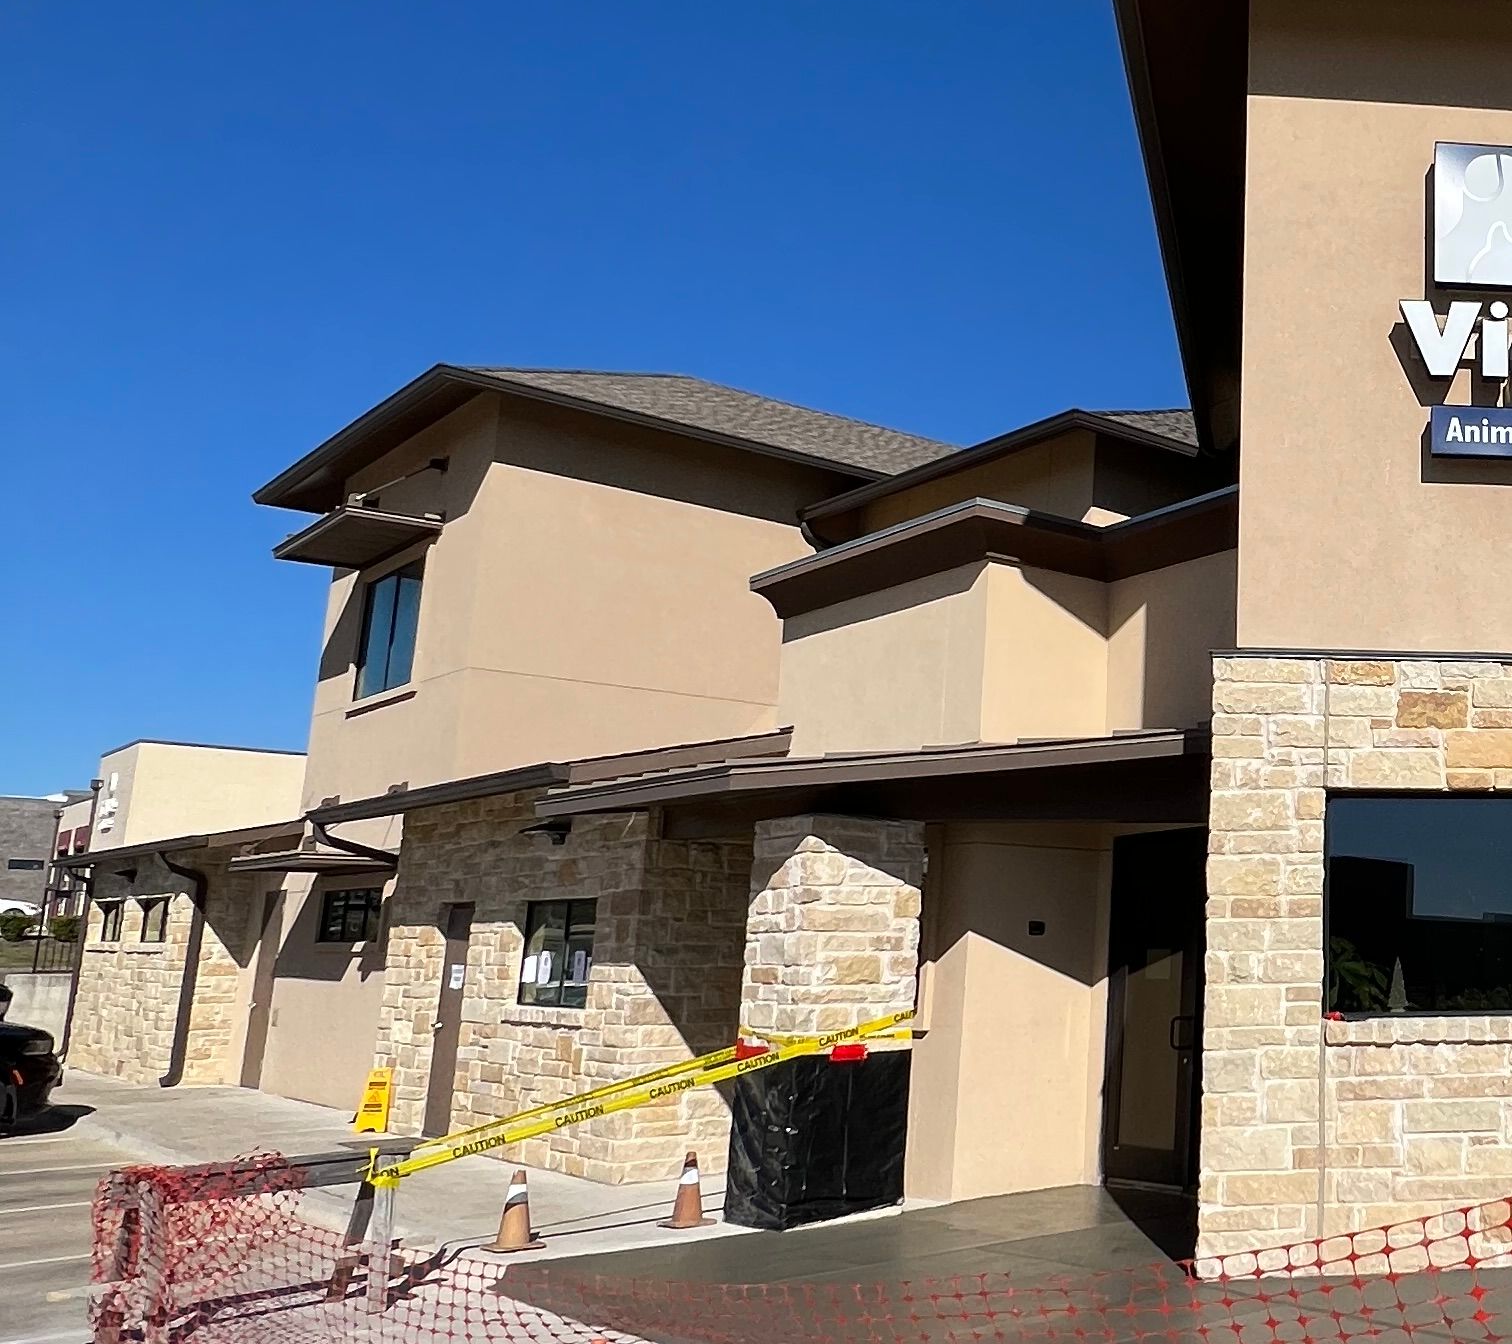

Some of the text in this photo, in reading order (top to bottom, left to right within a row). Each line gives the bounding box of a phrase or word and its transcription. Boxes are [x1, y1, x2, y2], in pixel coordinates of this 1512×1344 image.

[452, 1133, 506, 1158] CAUTION
[555, 1105, 605, 1128] CAUTION
[649, 1077, 696, 1099] CAUTION
[736, 1052, 780, 1073] CAUTION
[818, 1026, 859, 1047] CAUTION
[893, 1008, 918, 1023] CAUT
